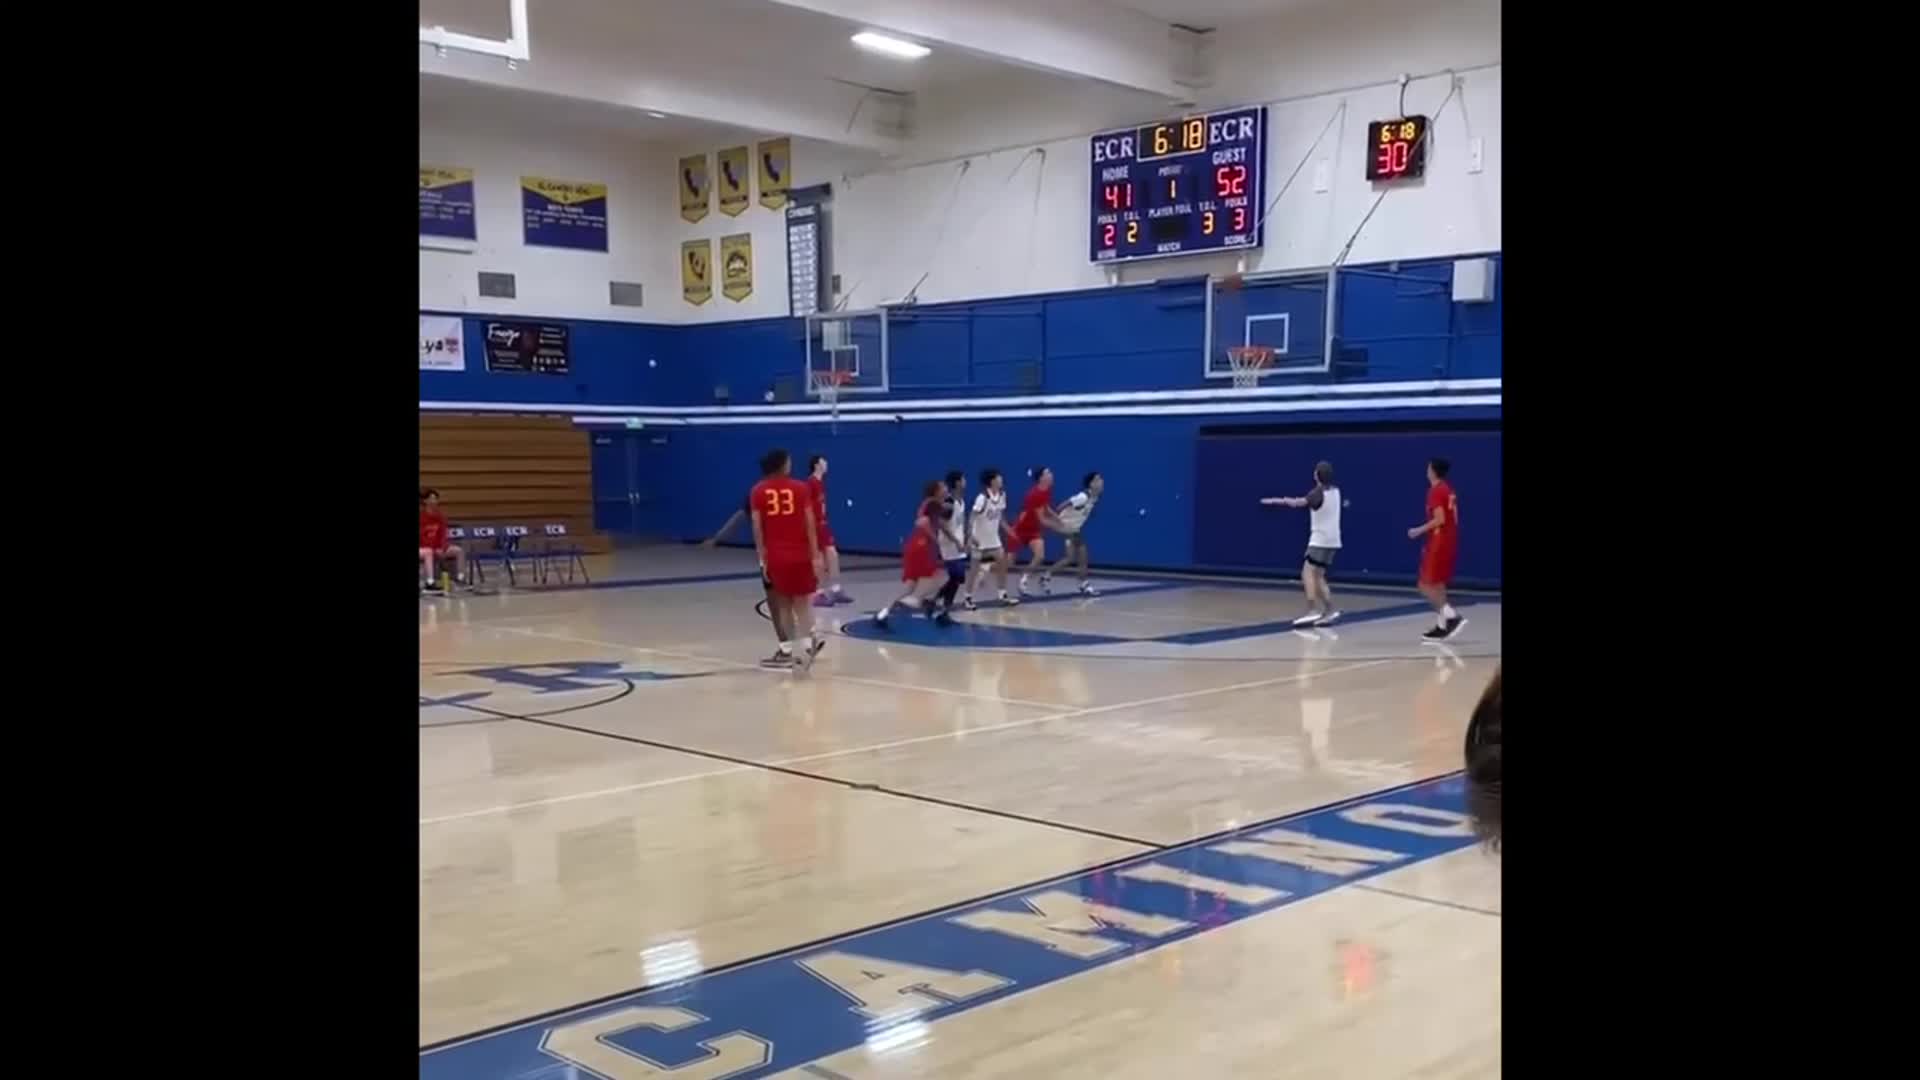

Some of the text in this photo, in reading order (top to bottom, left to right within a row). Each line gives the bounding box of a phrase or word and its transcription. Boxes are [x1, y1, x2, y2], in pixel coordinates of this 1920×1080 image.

[1154, 120, 1202, 154] 6:18
[1209, 116, 1254, 145] ECR
[1381, 121, 1416, 142] 6:18
[1094, 136, 1134, 163] ECR
[1212, 148, 1246, 165] GUEST
[1377, 141, 1408, 174] 30
[1102, 165, 1129, 181] HOME
[1217, 165, 1246, 196] 52
[1105, 183, 1132, 209] 41
[1170, 179, 1176, 199] 1
[1148, 204, 1192, 219] PLAYER FOUL
[1225, 198, 1248, 208] FOULS
[1097, 213, 1117, 224] FOULS
[1203, 212, 1214, 235] 3
[1234, 208, 1245, 231] 3
[1104, 224, 1115, 246] 2
[1127, 222, 1138, 243] 2
[1157, 242, 1181, 252] MATCH
[765, 488, 795, 516] 33
[473, 528, 495, 537] ECR
[506, 526, 528, 536] ECR
[545, 525, 566, 535] ECR
[537, 803, 1477, 1080] CAMINO
